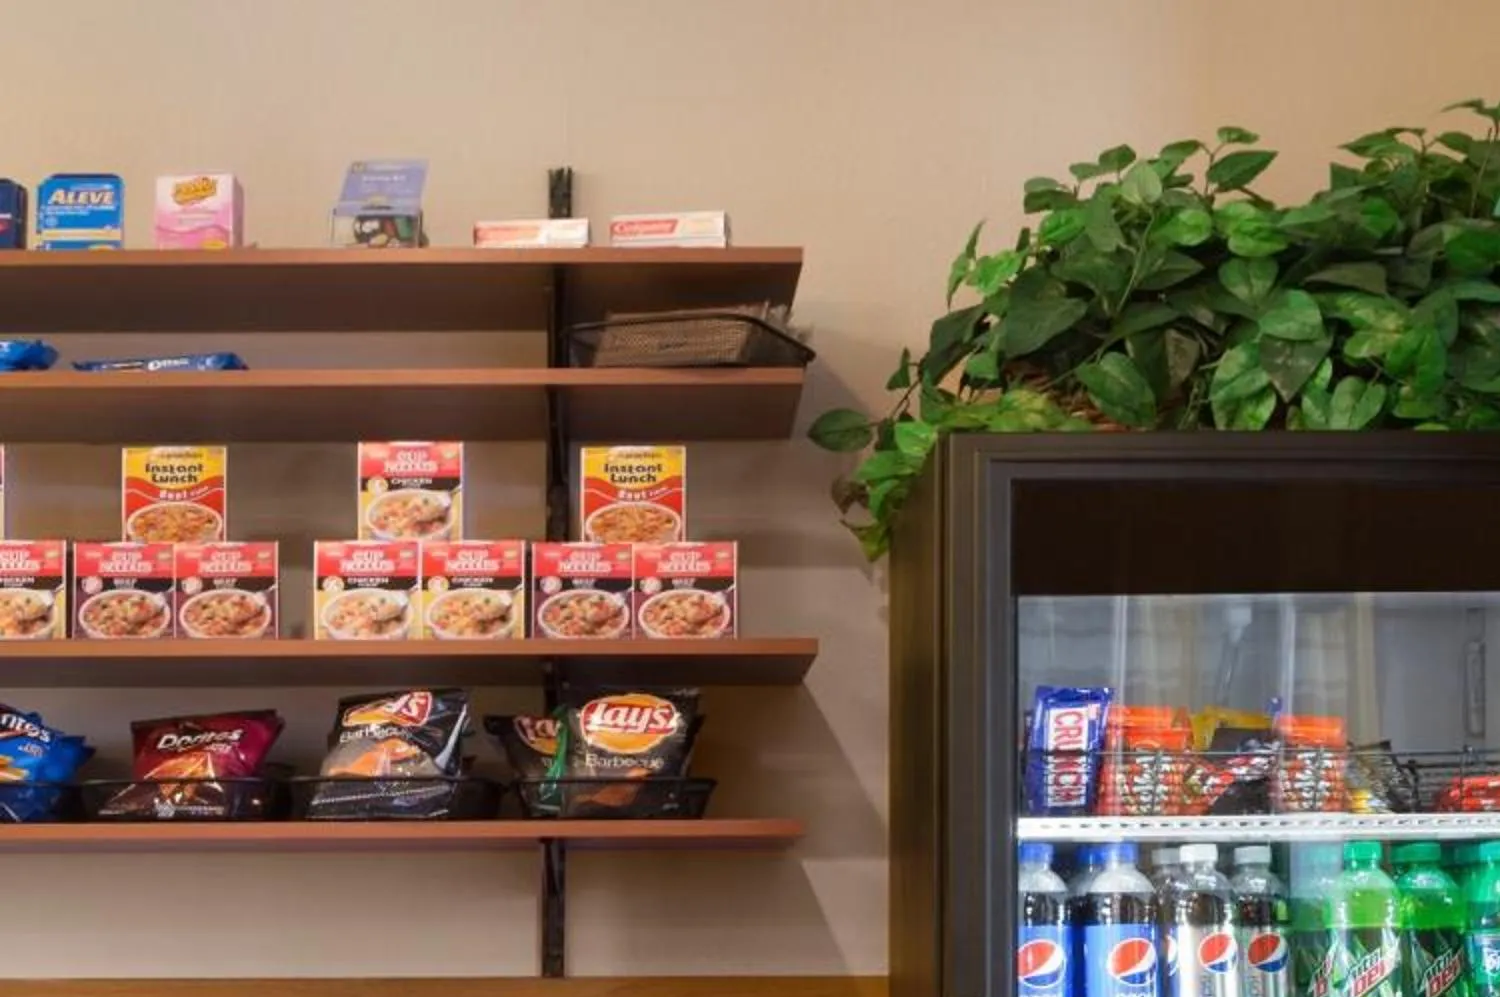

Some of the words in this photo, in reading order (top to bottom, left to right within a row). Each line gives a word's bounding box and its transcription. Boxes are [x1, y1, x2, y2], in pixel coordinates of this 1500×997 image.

[145, 464, 204, 475] Instant
[604, 464, 663, 474] Instant
[152, 474, 198, 483] Lunch
[610, 474, 657, 483] Lunch
[157, 729, 244, 750] Doritos
[584, 753, 666, 770] Barbecue
